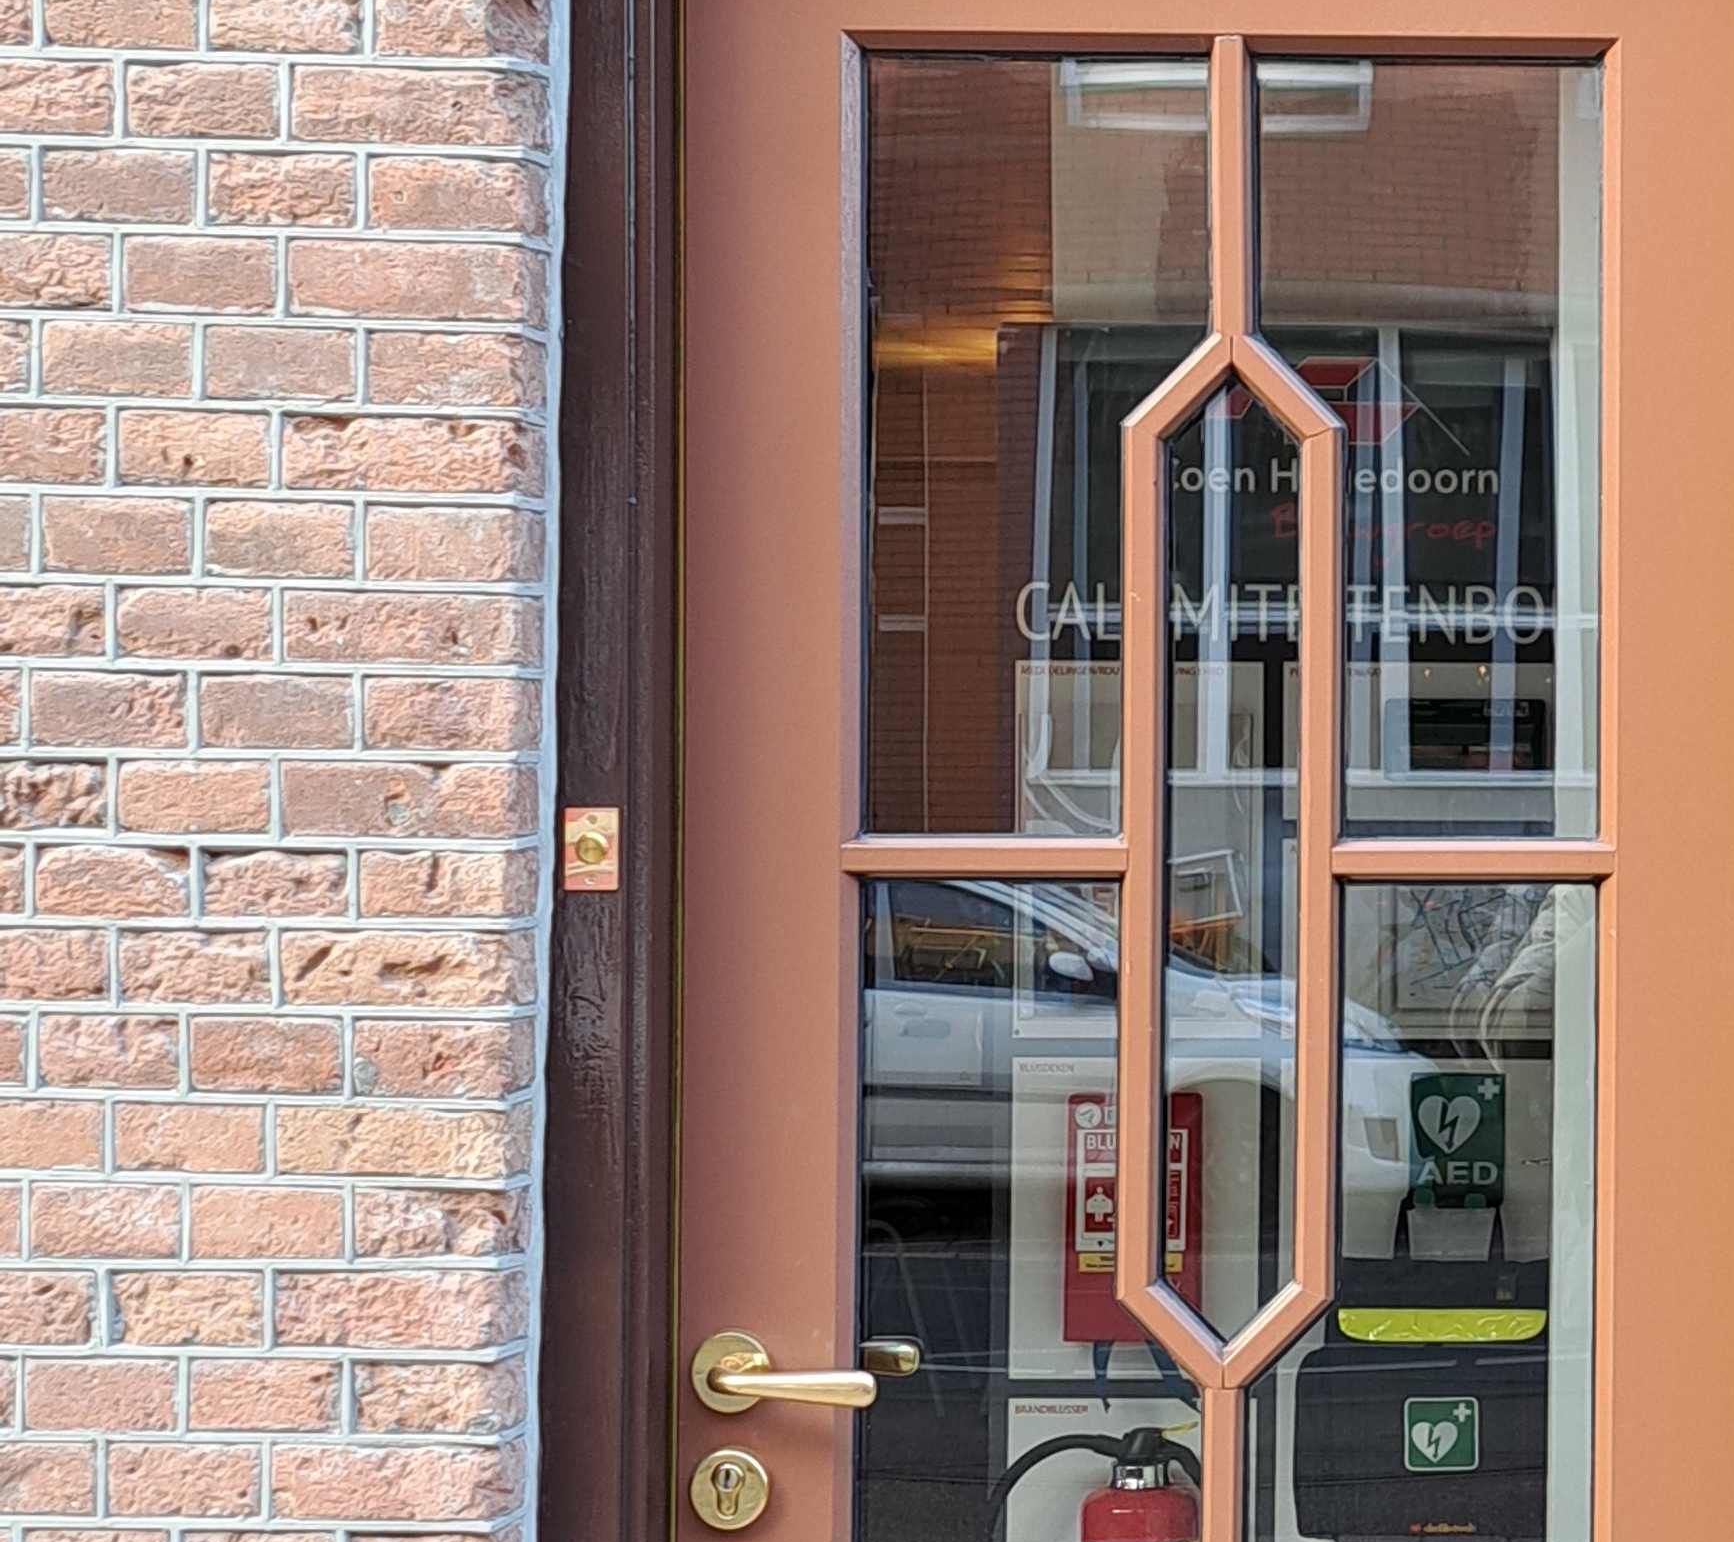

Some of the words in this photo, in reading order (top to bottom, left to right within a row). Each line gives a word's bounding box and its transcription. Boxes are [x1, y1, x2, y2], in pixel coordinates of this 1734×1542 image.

[1172, 458, 1256, 493] oen
[1270, 457, 1499, 494] Hedoorn
[1417, 1158, 1498, 1185] AED
